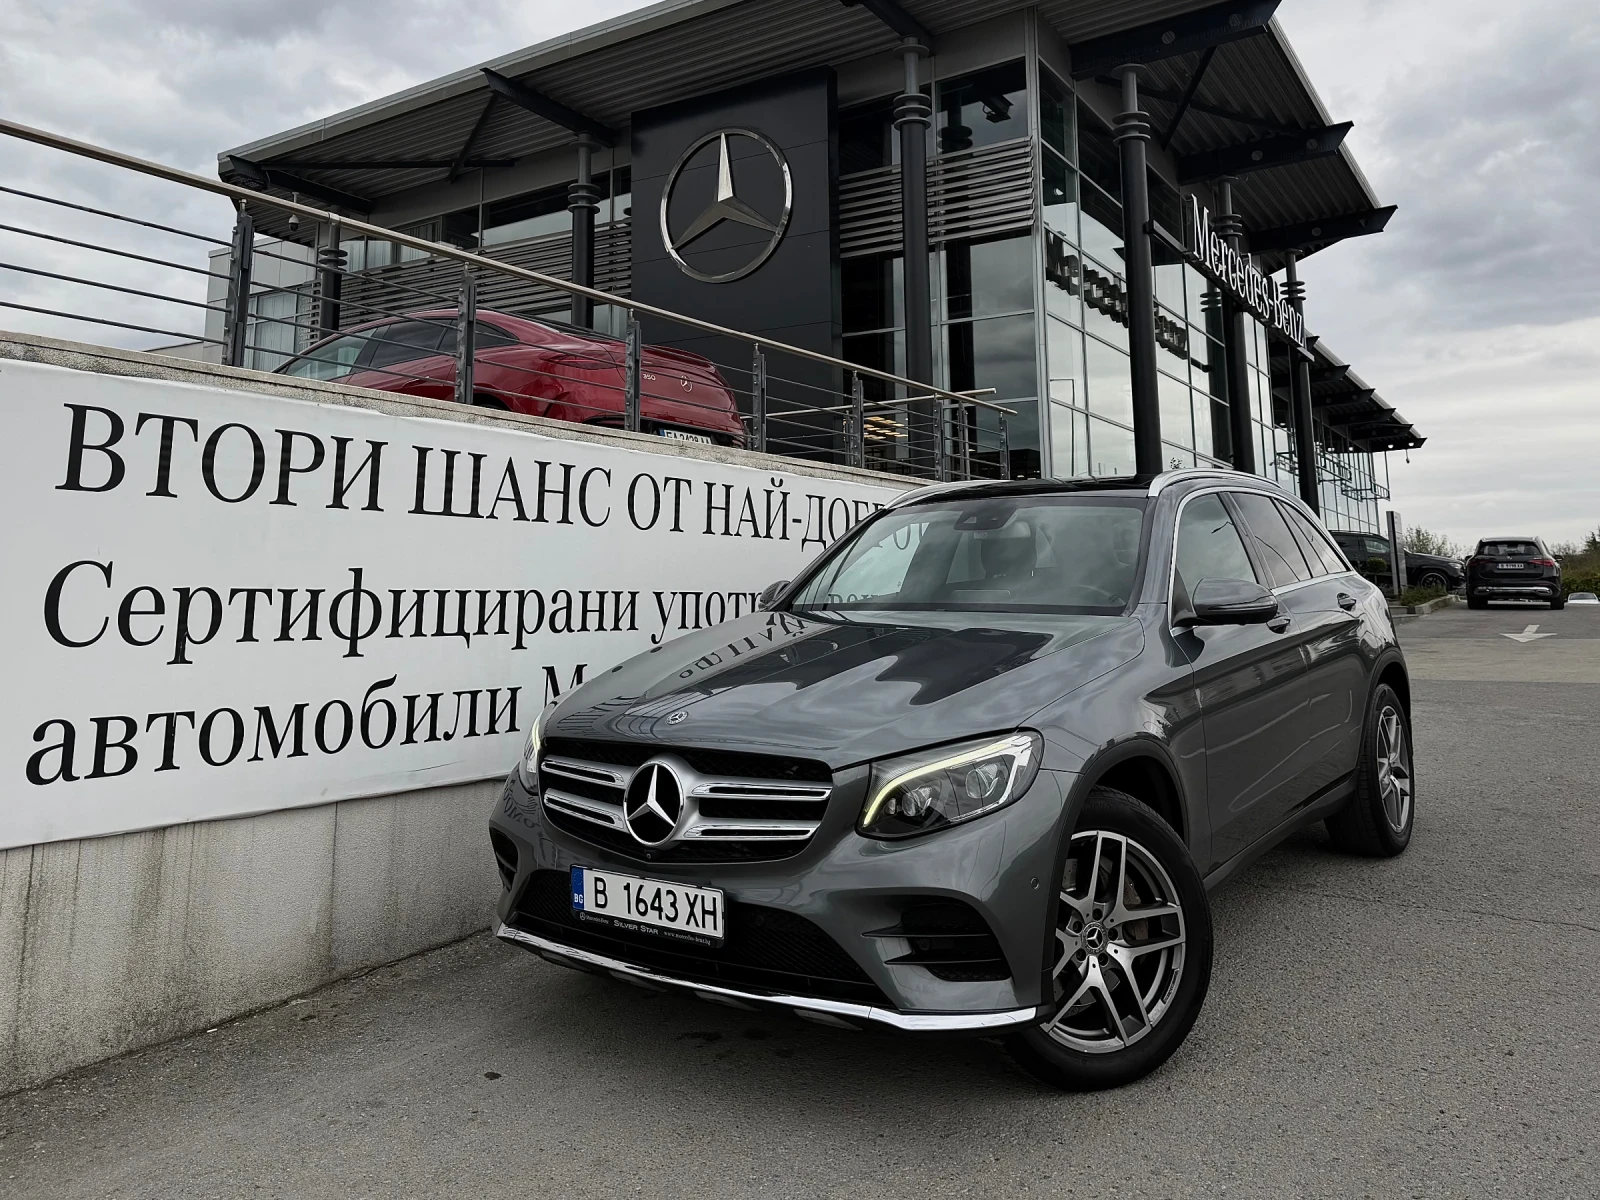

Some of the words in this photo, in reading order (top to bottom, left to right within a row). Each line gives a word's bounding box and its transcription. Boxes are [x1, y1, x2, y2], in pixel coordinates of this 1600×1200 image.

[1191, 193, 1305, 347] Mercedes-Benz
[55, 403, 388, 512] ВТОРИ
[408, 446, 612, 528] ШАНС
[628, 472, 692, 533] ОТ
[44, 561, 640, 665] Сертифицирани
[26, 674, 522, 785] автомобили
[573, 893, 584, 904] BG
[594, 877, 608, 909] B
[623, 882, 679, 923] 1643
[684, 891, 718, 931] XH
